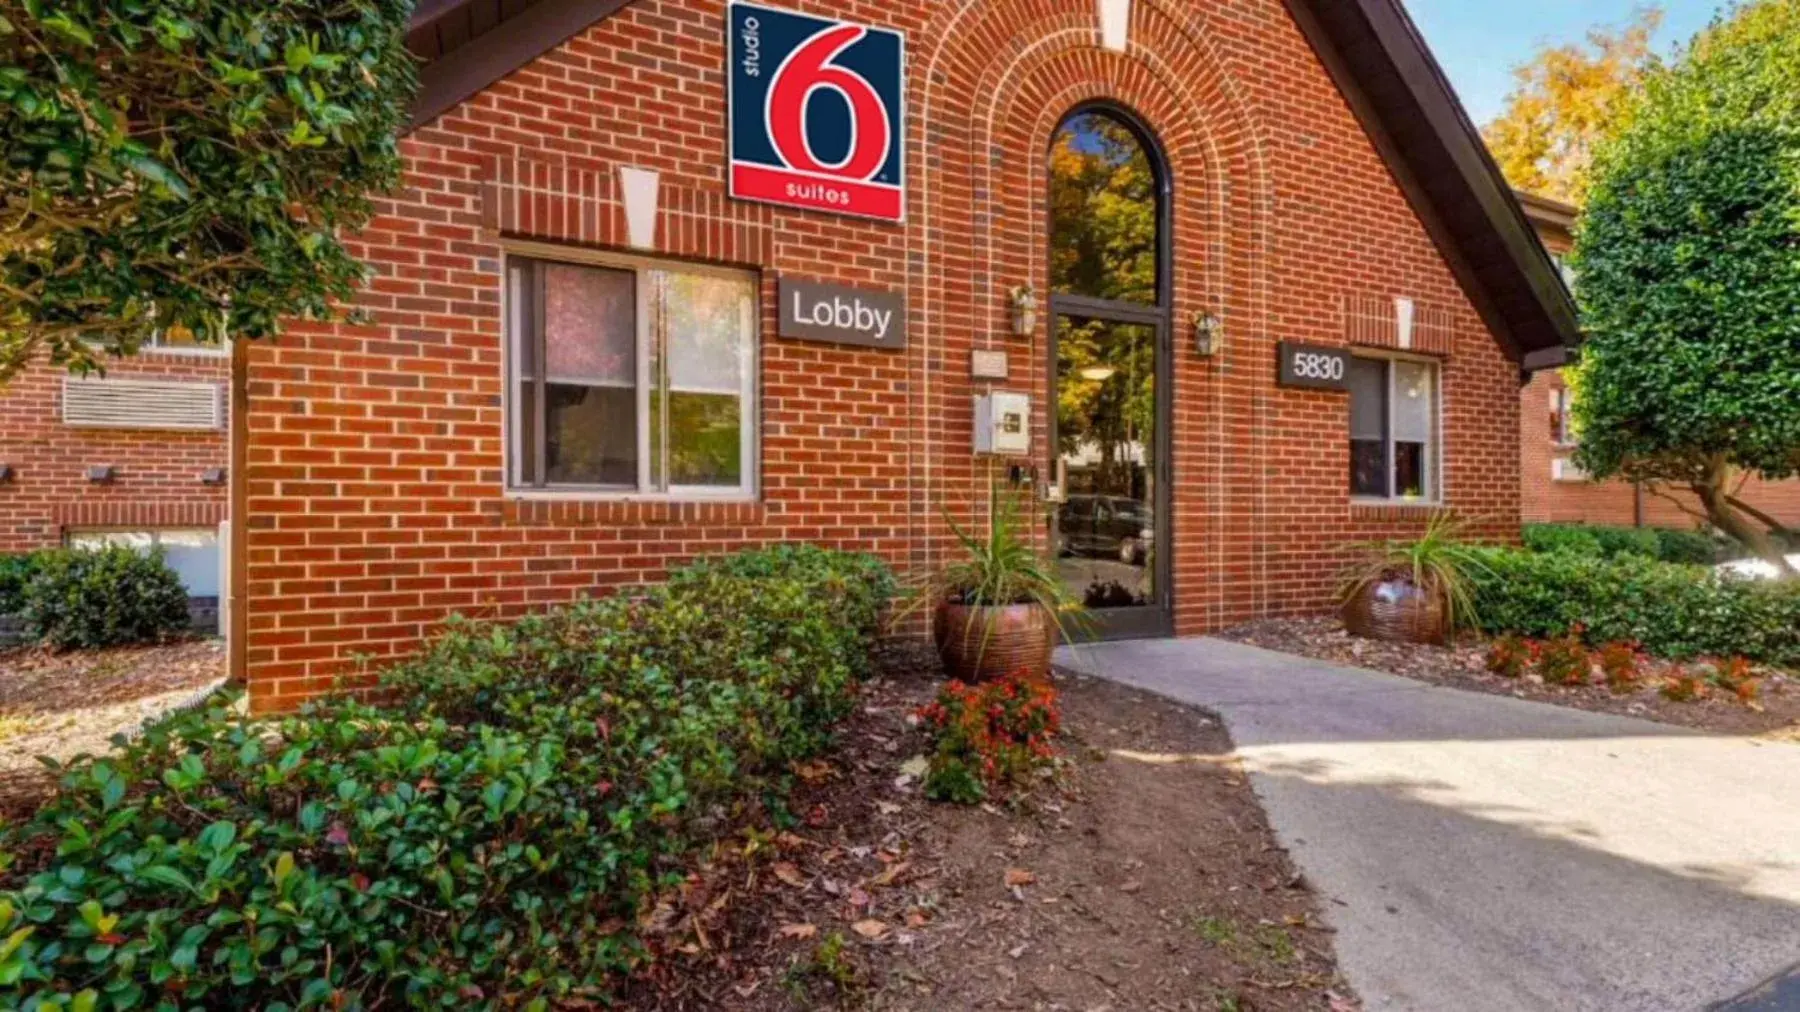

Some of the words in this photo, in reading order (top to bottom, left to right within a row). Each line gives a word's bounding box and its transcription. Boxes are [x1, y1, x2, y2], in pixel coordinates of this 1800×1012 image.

[741, 16, 759, 77] studio
[764, 22, 891, 181] 6
[785, 182, 850, 205] suites
[793, 290, 892, 339] Lobby
[1293, 352, 1344, 380] 5830
